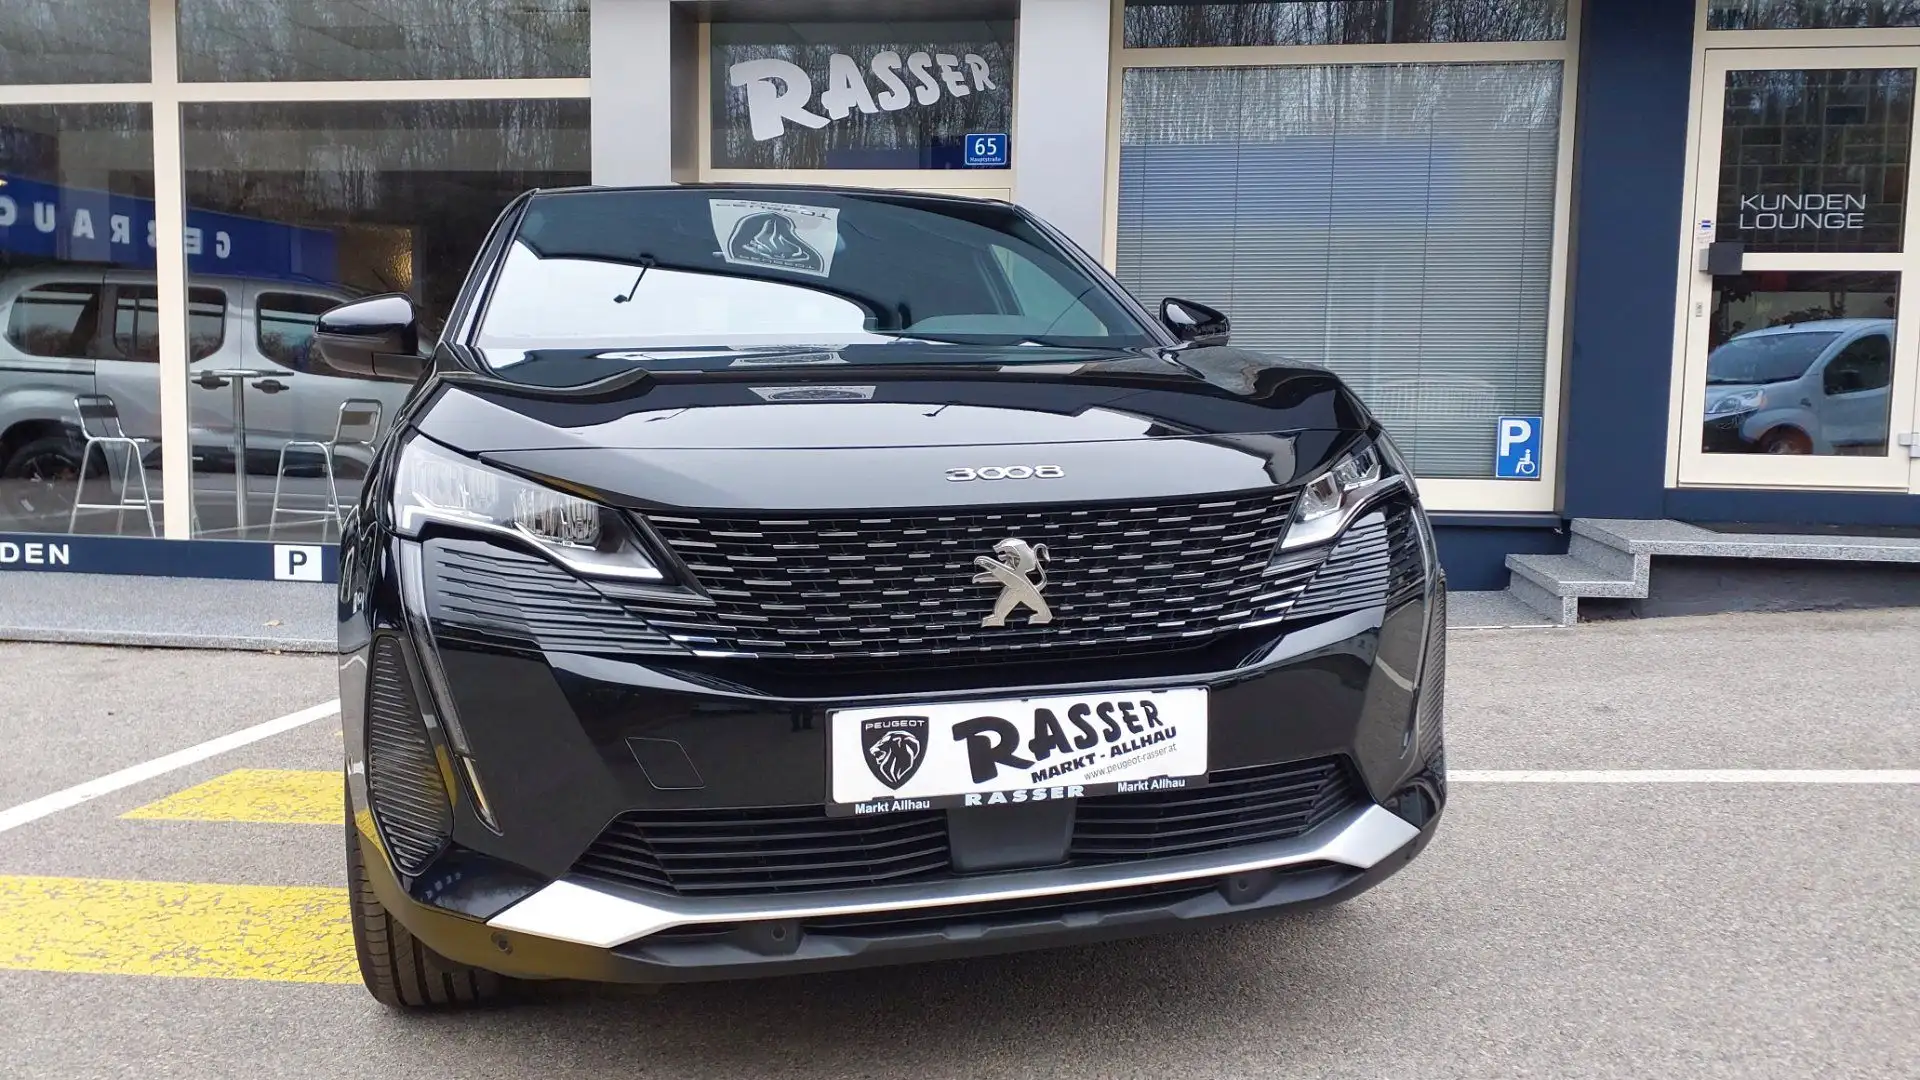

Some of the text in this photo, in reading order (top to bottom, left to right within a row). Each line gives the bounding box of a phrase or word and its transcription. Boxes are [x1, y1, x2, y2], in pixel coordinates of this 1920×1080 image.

[730, 51, 996, 141] RASSER
[975, 138, 997, 156] 65
[1740, 194, 1866, 210] KUNDEN
[1739, 213, 1865, 229] LOUNGE
[1500, 420, 1531, 456] P
[945, 465, 1065, 481] 3008
[0, 541, 69, 565] DEN
[288, 550, 307, 575] P
[865, 720, 925, 731] PEUGEOT
[952, 700, 1164, 784] RASSER
[1031, 753, 1096, 784] MARKT
[1110, 726, 1177, 758] ALLHAU
[1084, 742, 1177, 780] www.peugeot-rasser.at
[965, 785, 1084, 806] RASSER
[1117, 778, 1186, 793] Markt Allhau
[855, 799, 930, 815] Markt Allhau
